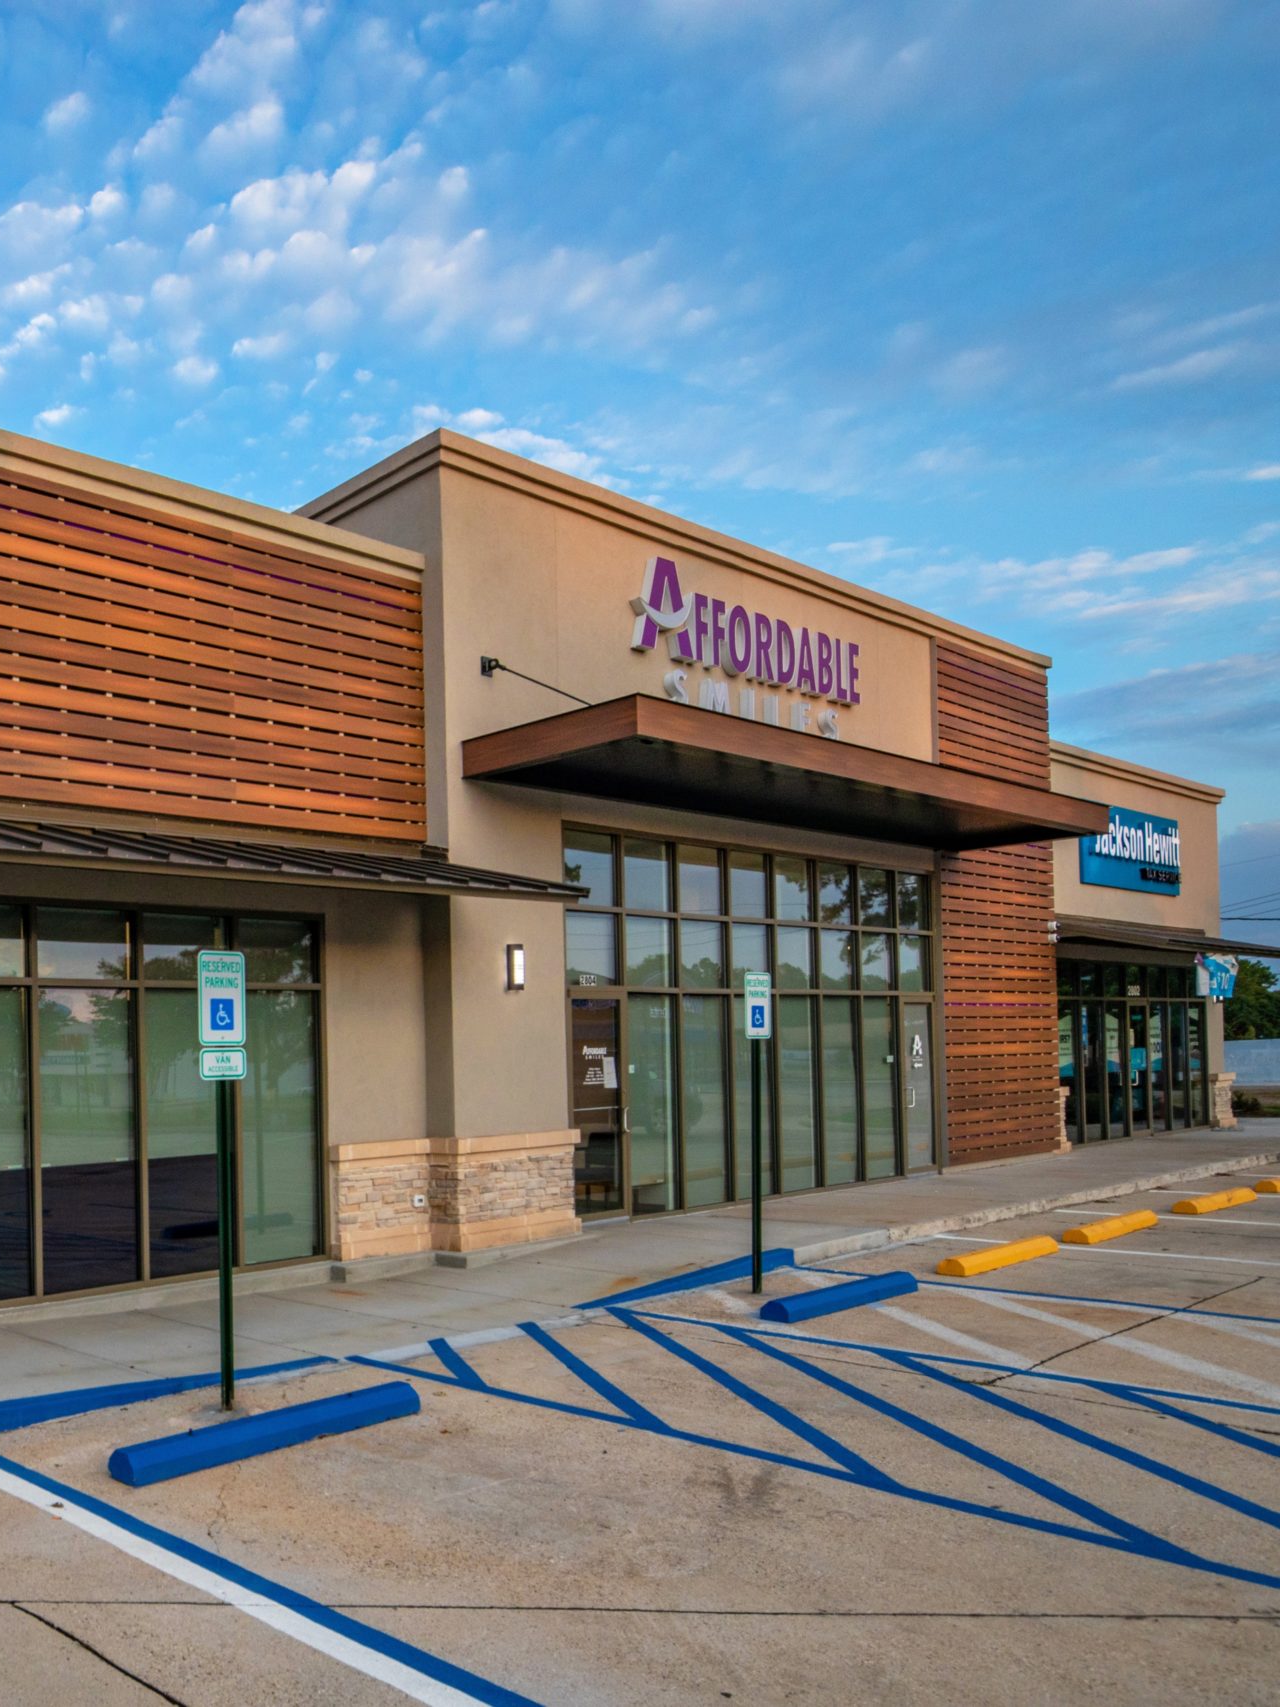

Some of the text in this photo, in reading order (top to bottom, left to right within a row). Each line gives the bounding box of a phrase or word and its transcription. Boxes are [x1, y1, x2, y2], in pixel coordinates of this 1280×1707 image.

[630, 556, 861, 707] AFFORDABLE
[1145, 821, 1181, 867] Hewitt
[202, 960, 240, 973] RESERVED
[205, 976, 238, 988] PARKING
[746, 979, 769, 988] RESERVED
[748, 990, 768, 998] PARKING
[215, 1055, 231, 1064] VAN
[208, 1065, 238, 1073] ACCESSIBLE
